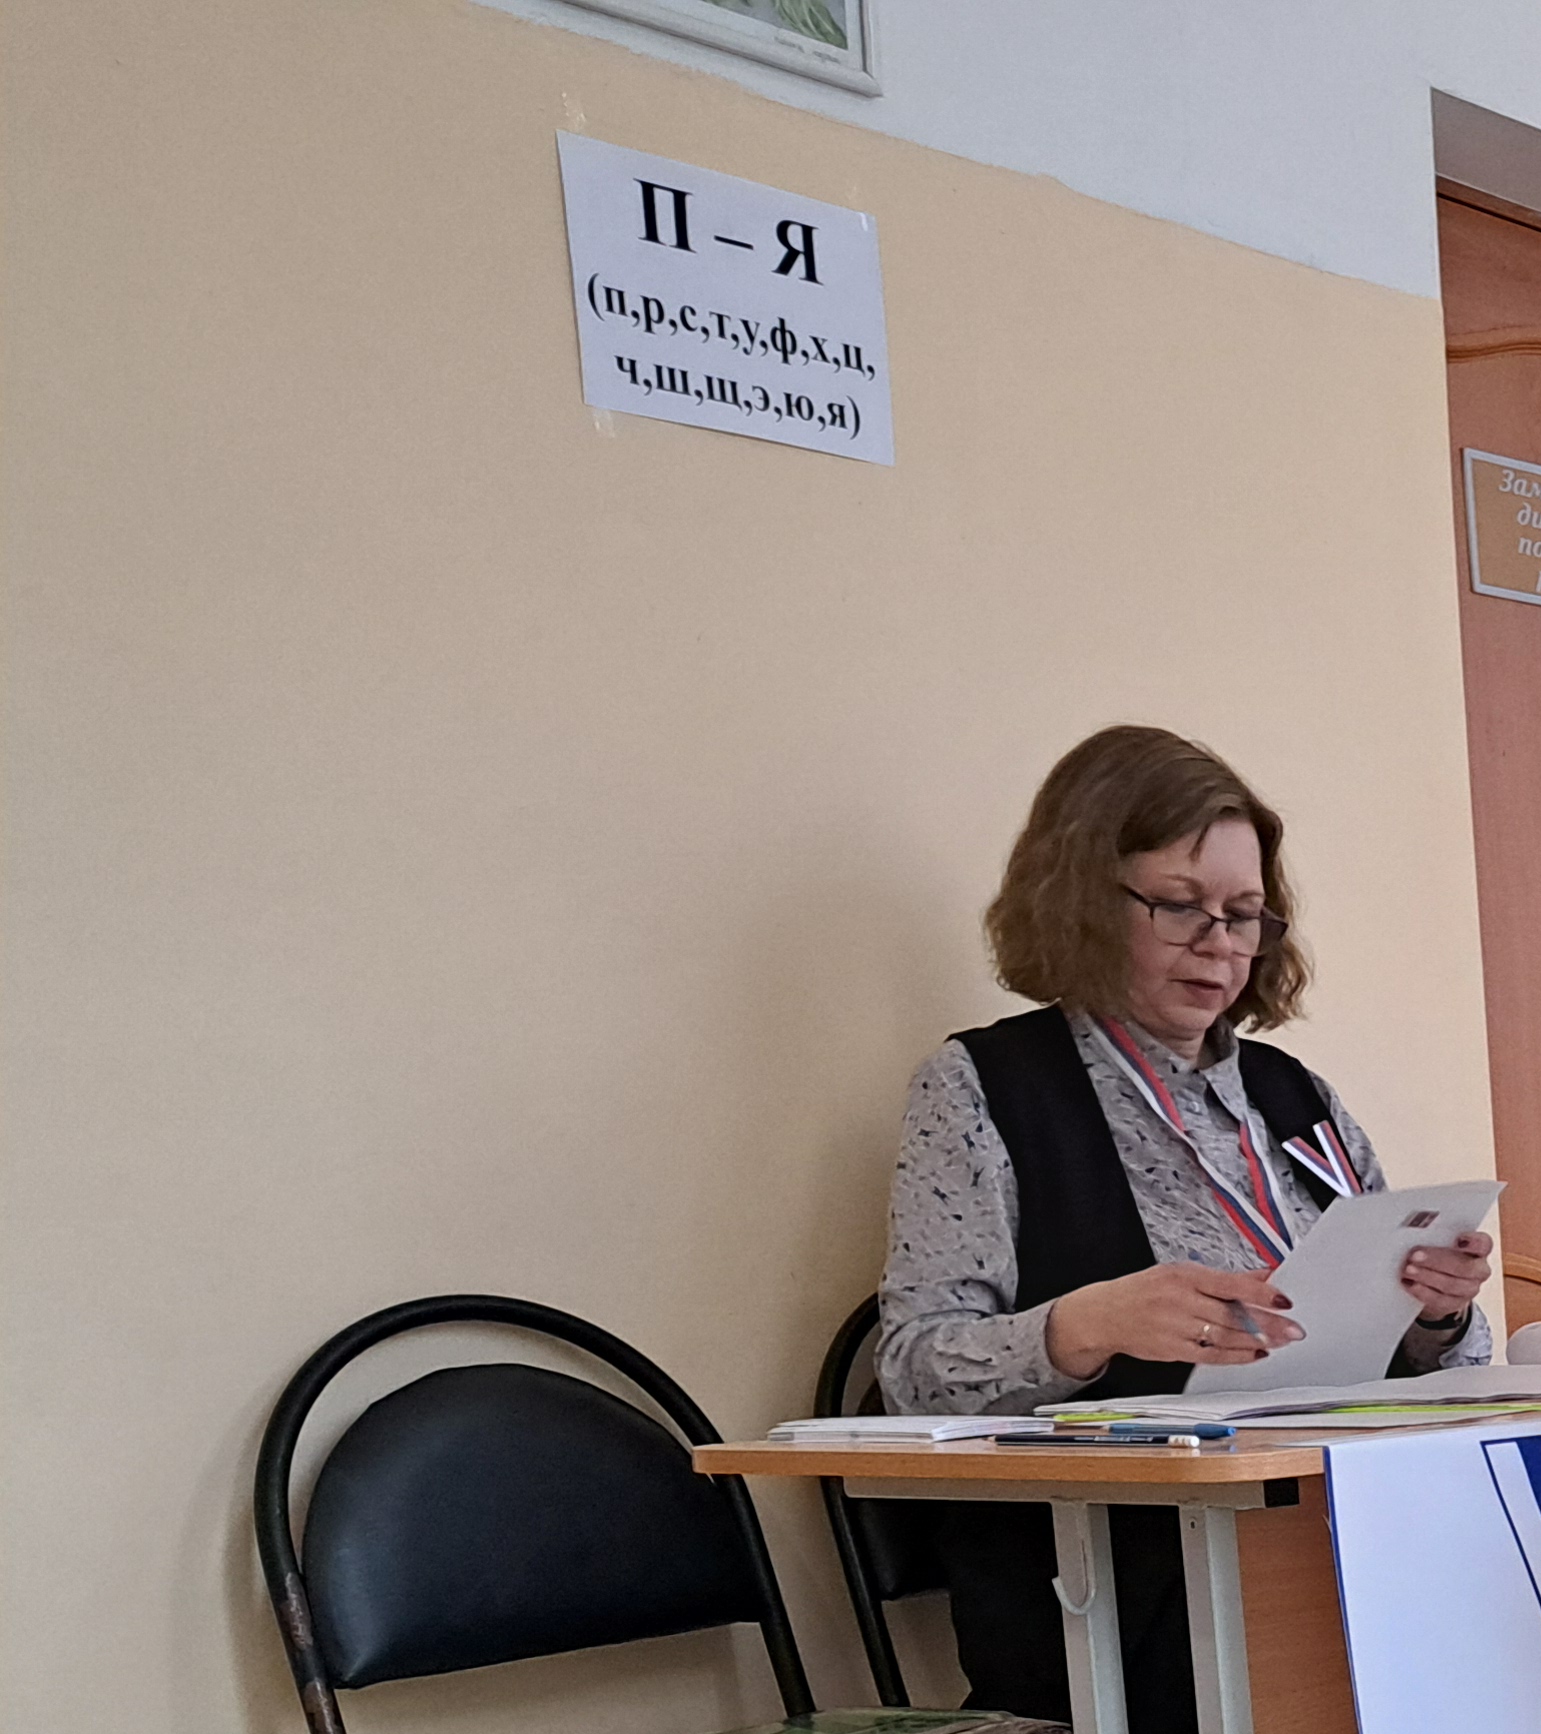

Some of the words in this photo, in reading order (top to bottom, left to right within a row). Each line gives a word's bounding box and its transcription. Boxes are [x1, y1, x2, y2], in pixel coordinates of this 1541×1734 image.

[633, 177, 697, 254] П
[771, 219, 825, 286] Я
[587, 272, 876, 380] (п,р,с,т,у,ф,х,ц,
[613, 354, 862, 440] ч,ш,щ,э,ю,я)
